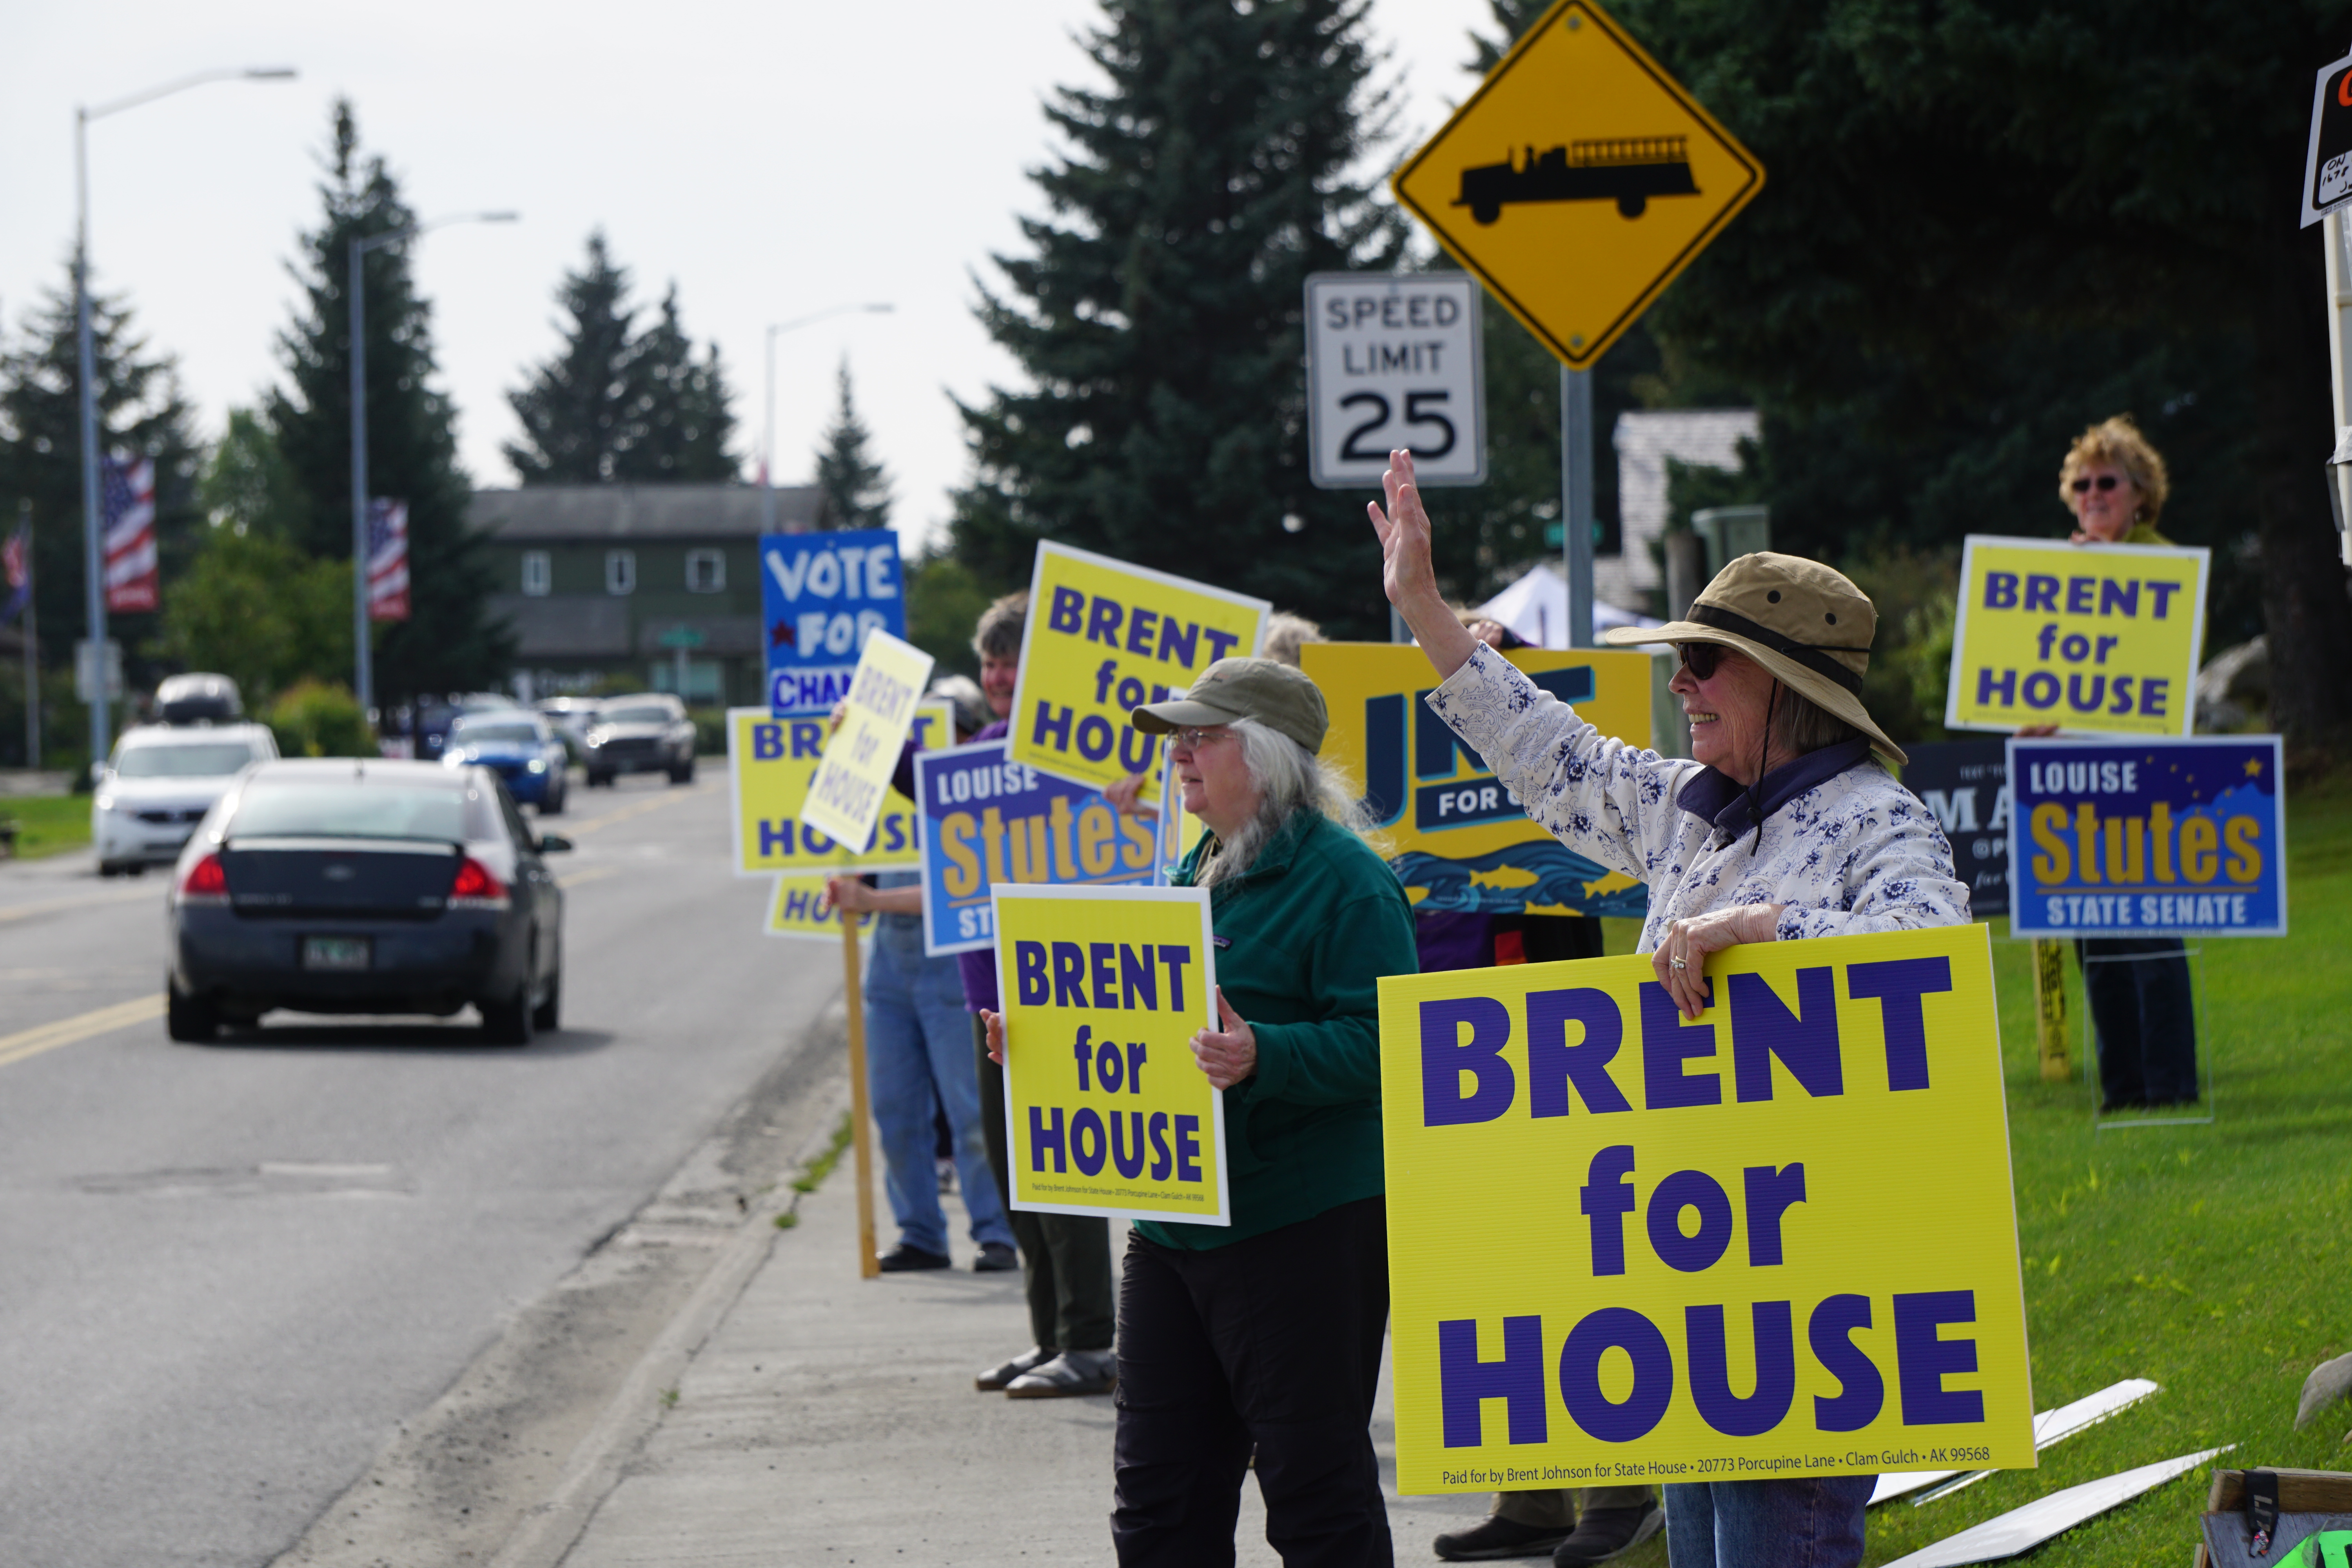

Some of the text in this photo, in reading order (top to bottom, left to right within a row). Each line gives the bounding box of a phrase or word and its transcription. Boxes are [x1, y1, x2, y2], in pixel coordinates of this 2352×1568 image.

[1327, 296, 1460, 330] SPEED
[1342, 342, 1446, 376] LIMIT
[1339, 390, 1456, 461] 25
[766, 544, 898, 603] VOTE
[1983, 571, 2181, 619] BRENT
[1049, 585, 1239, 670] BRENT
[2037, 623, 2118, 664] for
[1976, 667, 2169, 717] HOUSE
[937, 764, 1039, 805] LOUISE
[1439, 786, 1498, 817] FOR
[2030, 762, 2138, 794] LOUISE
[941, 795, 1157, 897] Stutes
[2031, 801, 2261, 885] Stutes
[2047, 895, 2246, 927] STATE SENATE
[1016, 941, 1191, 1012] BRENT
[1074, 1025, 1147, 1094] for
[1419, 956, 1953, 1127] BRENT
[1029, 1106, 1202, 1182] HOUSE
[1580, 1145, 1807, 1276] for
[1438, 1289, 1985, 1448] HOUSE
[1443, 1446, 1990, 1486] Paid for by Brent Johnson for State House 20773 Porcupine Lane Clam Gulch AK 99568
